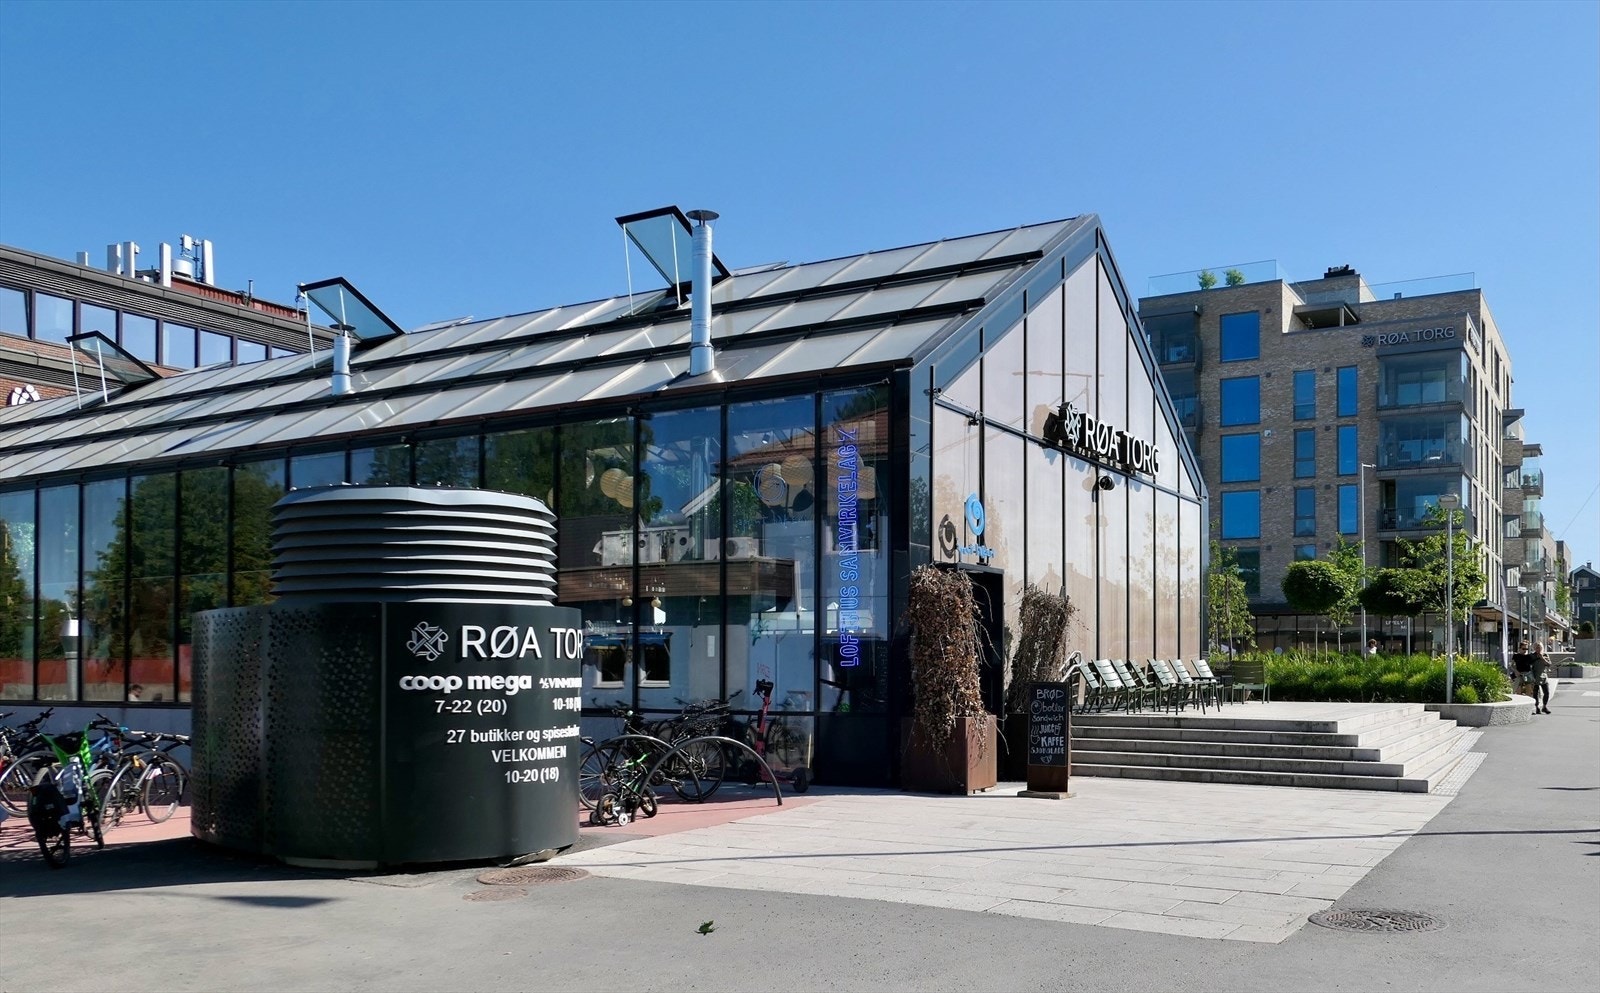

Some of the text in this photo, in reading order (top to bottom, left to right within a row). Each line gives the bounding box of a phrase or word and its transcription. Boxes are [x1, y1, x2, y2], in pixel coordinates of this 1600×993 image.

[1378, 326, 1455, 345] RØA TORG
[1085, 412, 1161, 476] RØA TORG
[840, 585, 859, 667] LOFTHUS
[461, 625, 542, 659] RØA
[399, 675, 532, 696] coop mega
[435, 699, 507, 716] 7-22 (20)
[446, 729, 466, 743] 27
[470, 729, 524, 743] butikker
[526, 730, 541, 743] og
[1041, 736, 1064, 747] KAFFE
[491, 745, 567, 763] VELKOMMEN
[505, 767, 560, 783] 10-20 (18)
